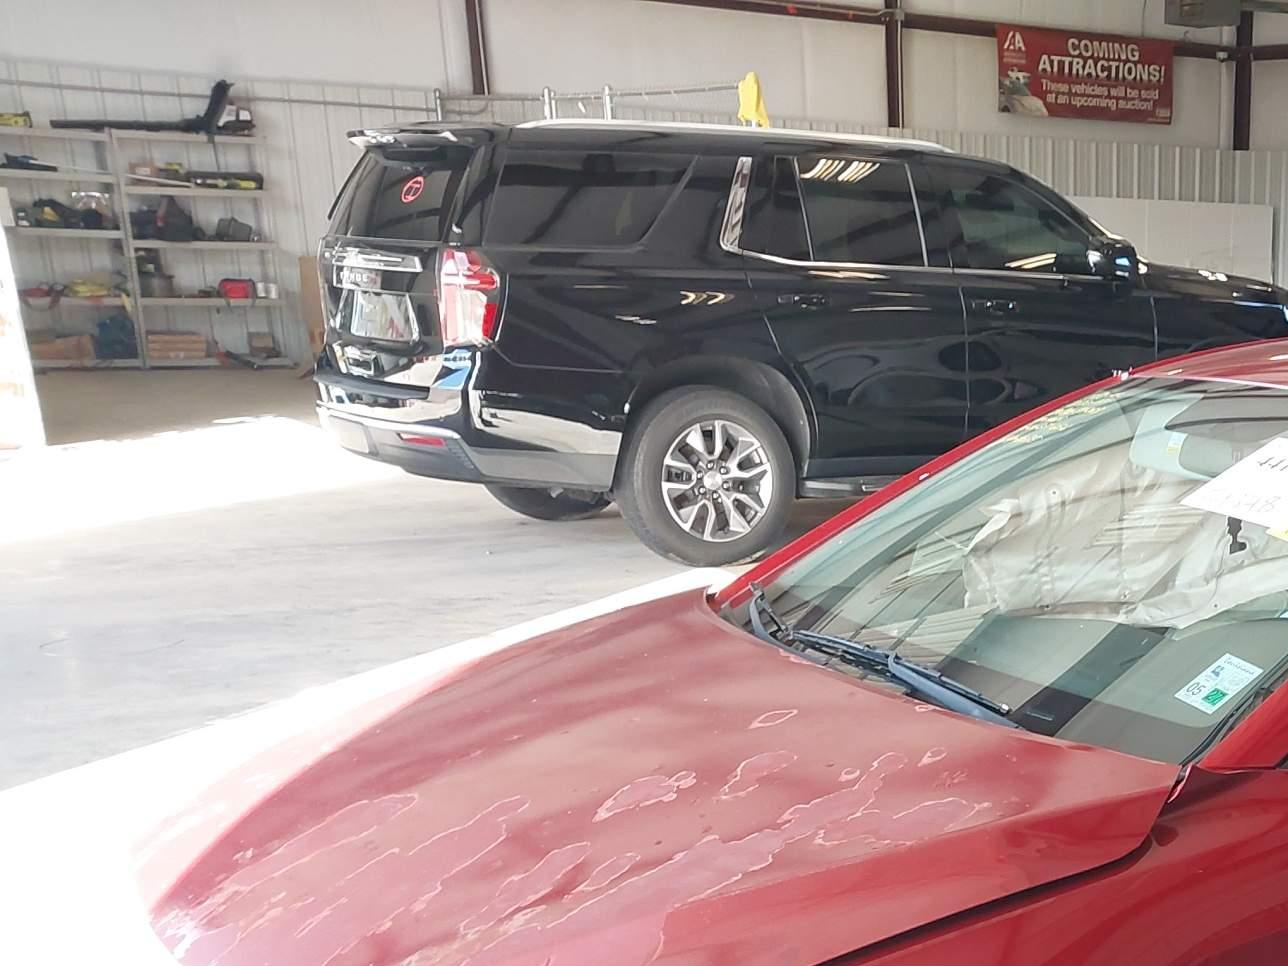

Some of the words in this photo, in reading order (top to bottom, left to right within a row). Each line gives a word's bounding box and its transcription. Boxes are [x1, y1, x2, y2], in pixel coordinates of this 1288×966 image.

[1068, 38, 1140, 61] COMING
[1038, 55, 1166, 83] ATTRACTIONS!
[1041, 79, 1069, 94] These
[1071, 83, 1108, 96] vehicles
[1110, 85, 1125, 97] will
[1127, 87, 1139, 99] be
[1141, 88, 1159, 100] sold
[1046, 93, 1056, 103] at
[1057, 94, 1070, 105] an
[1071, 94, 1116, 111] upcoming
[1186, 682, 1207, 696] 05
